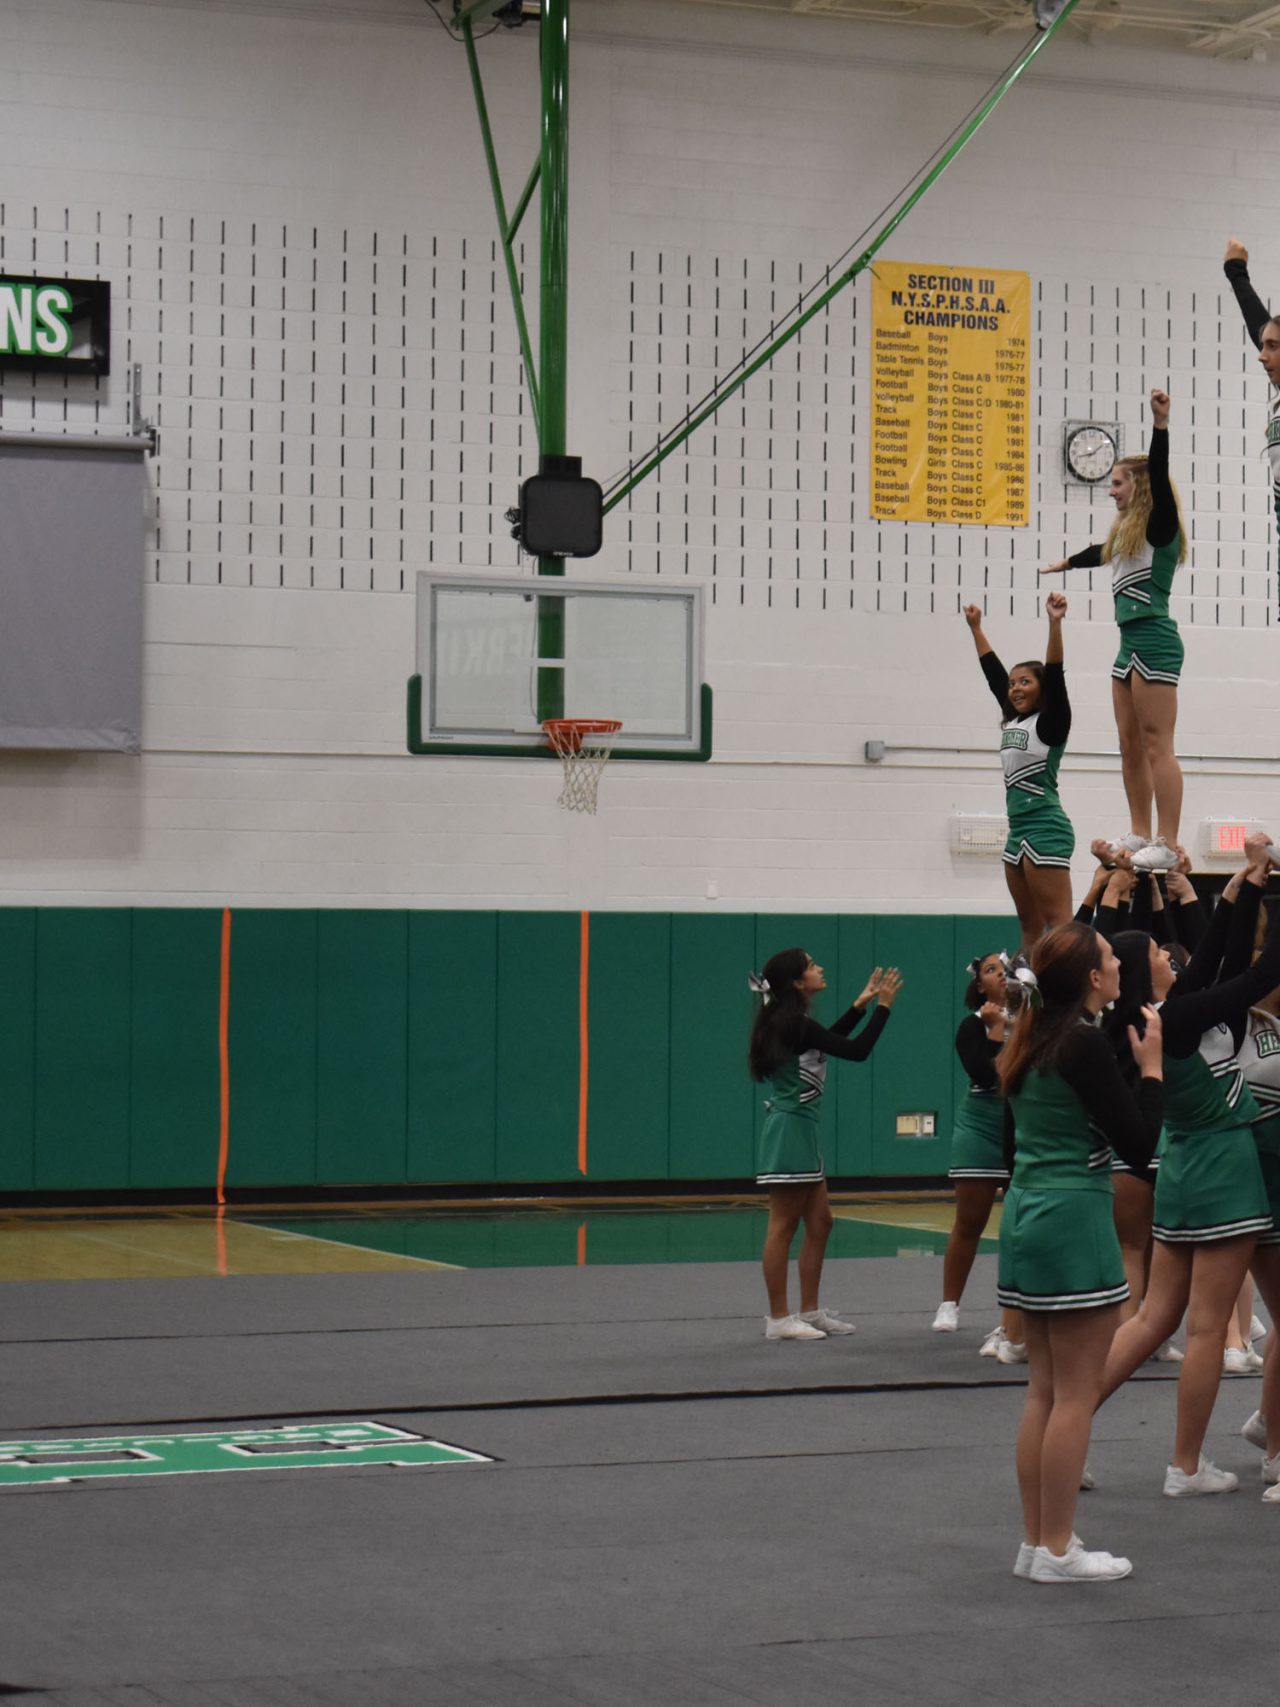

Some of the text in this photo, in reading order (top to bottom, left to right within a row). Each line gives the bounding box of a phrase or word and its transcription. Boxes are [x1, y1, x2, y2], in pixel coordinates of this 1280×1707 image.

[908, 274, 995, 295] SECTION III
[892, 291, 1011, 314] N.Y.S.P.H.S.A.A.
[904, 310, 999, 331] CHAMPIONS
[876, 329, 1025, 346] Baseball Boys 1974
[876, 341, 919, 352] Badminton
[928, 345, 948, 355] Boys
[876, 353, 897, 364] Table
[900, 355, 925, 366] Tennis
[928, 358, 948, 368] Boys
[876, 367, 914, 378] Volleyball
[928, 370, 948, 381] Boys
[952, 371, 974, 381] Class
[876, 379, 908, 389] Football
[928, 383, 948, 393] Boys
[952, 384, 974, 394] Class
[876, 392, 914, 403] Volleyball
[928, 395, 948, 406] Boys
[952, 396, 974, 407] Class
[876, 404, 897, 414] Track
[928, 408, 948, 418] Boys
[952, 409, 974, 419] Class
[875, 417, 910, 427] Baseball
[928, 421, 948, 431] Boys
[952, 422, 974, 432] Class
[875, 430, 908, 440] Football
[928, 433, 948, 443] Boys
[952, 435, 974, 445] Class
[875, 443, 908, 453] Football
[928, 446, 948, 456] Boys
[952, 447, 974, 457] Class
[875, 455, 908, 467] Bowling
[928, 458, 947, 468] Girls
[952, 460, 974, 470] Class
[875, 468, 897, 478] Track
[928, 471, 948, 481] Boys
[952, 472, 974, 482] Class
[875, 481, 910, 491] Baseball
[928, 483, 948, 493] Boys
[952, 485, 974, 495] Class
[875, 493, 910, 504] Baseball
[928, 496, 948, 506] Boys
[952, 497, 974, 508] Class
[875, 506, 897, 516] Track
[928, 508, 948, 519] Boys
[952, 510, 974, 520] Class
[1218, 825, 1247, 849] EXIT
